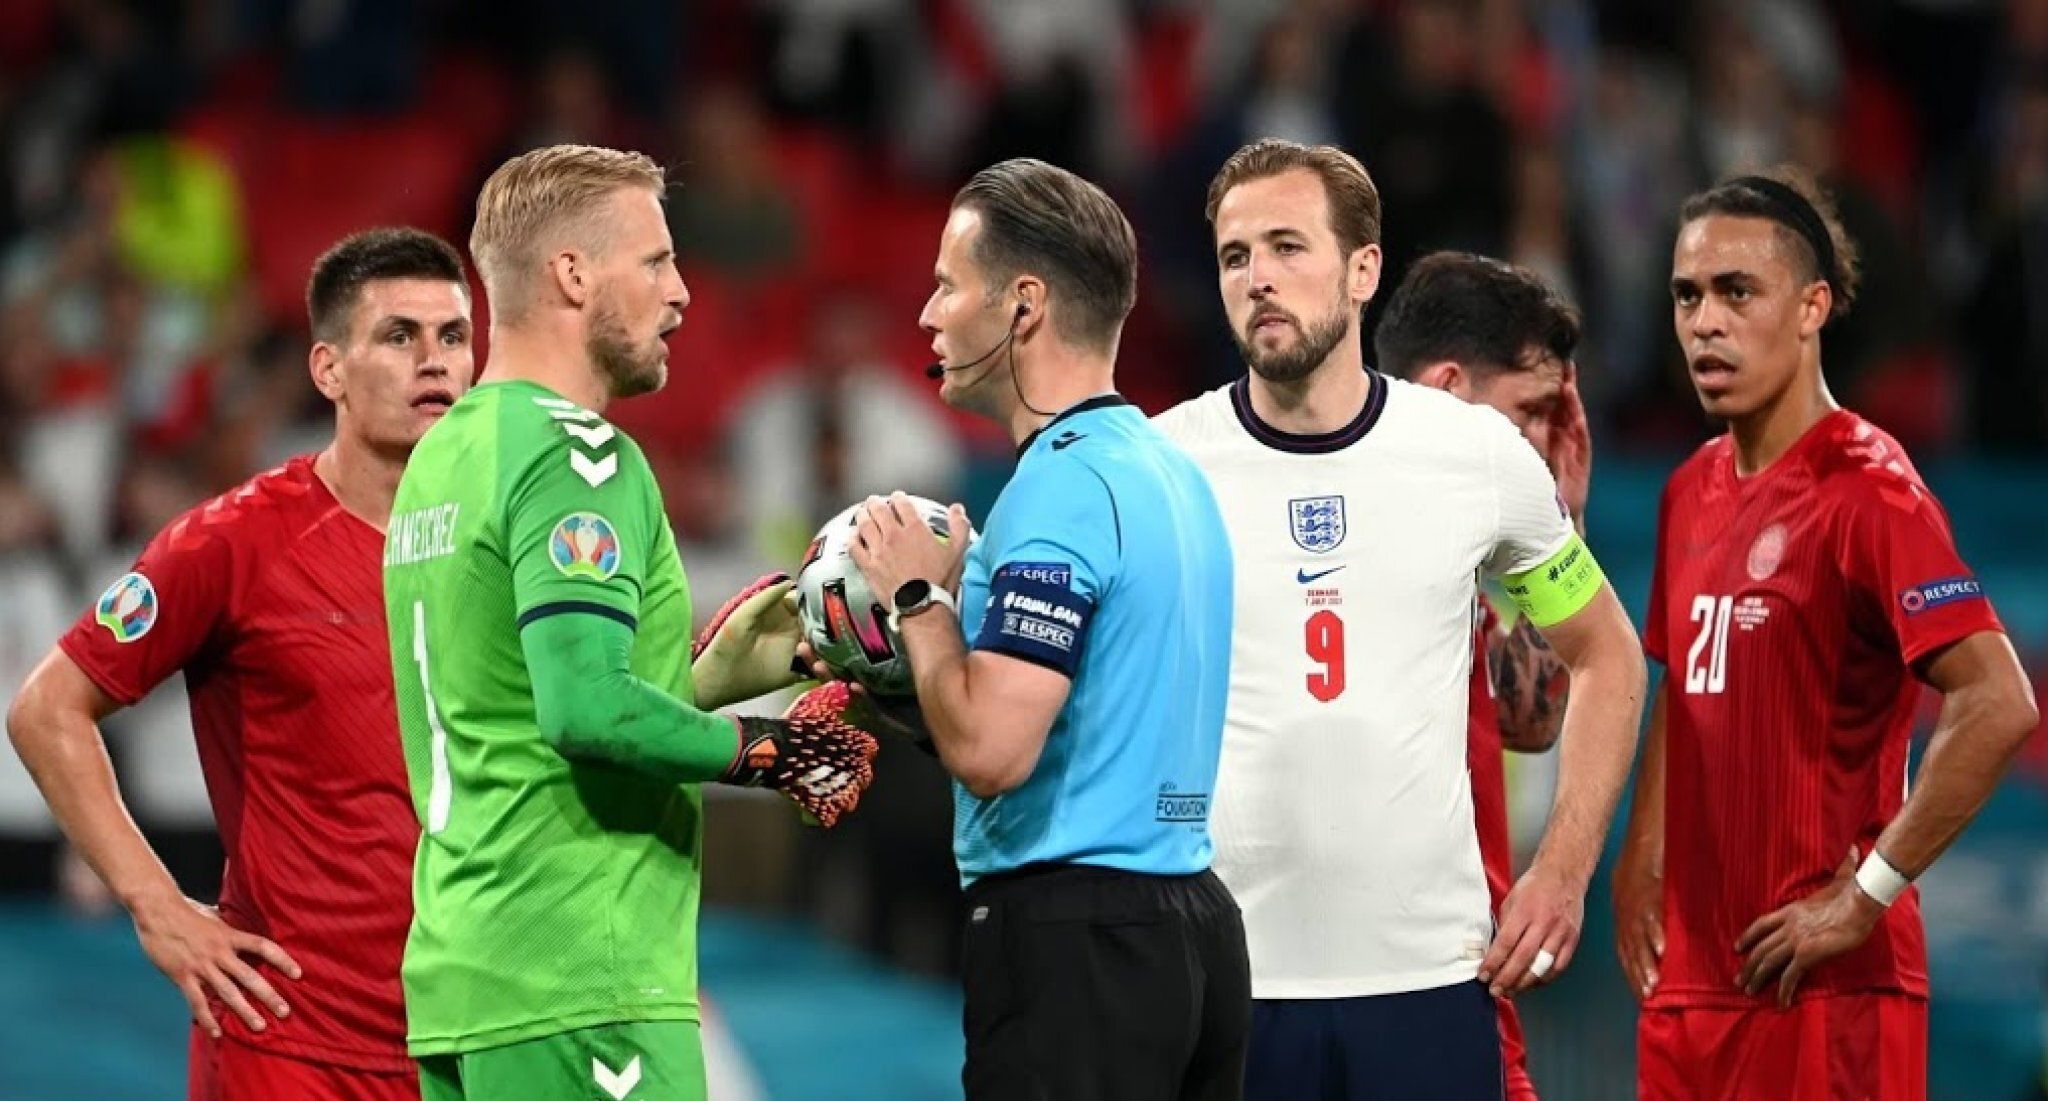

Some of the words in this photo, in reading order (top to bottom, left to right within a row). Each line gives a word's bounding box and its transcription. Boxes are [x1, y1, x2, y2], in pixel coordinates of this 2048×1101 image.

[1019, 619, 1074, 648] RESPECT
[1924, 581, 1980, 600] RESPECT
[1305, 609, 1345, 703] 9
[1685, 595, 1734, 693] 20
[413, 600, 453, 834] 1
